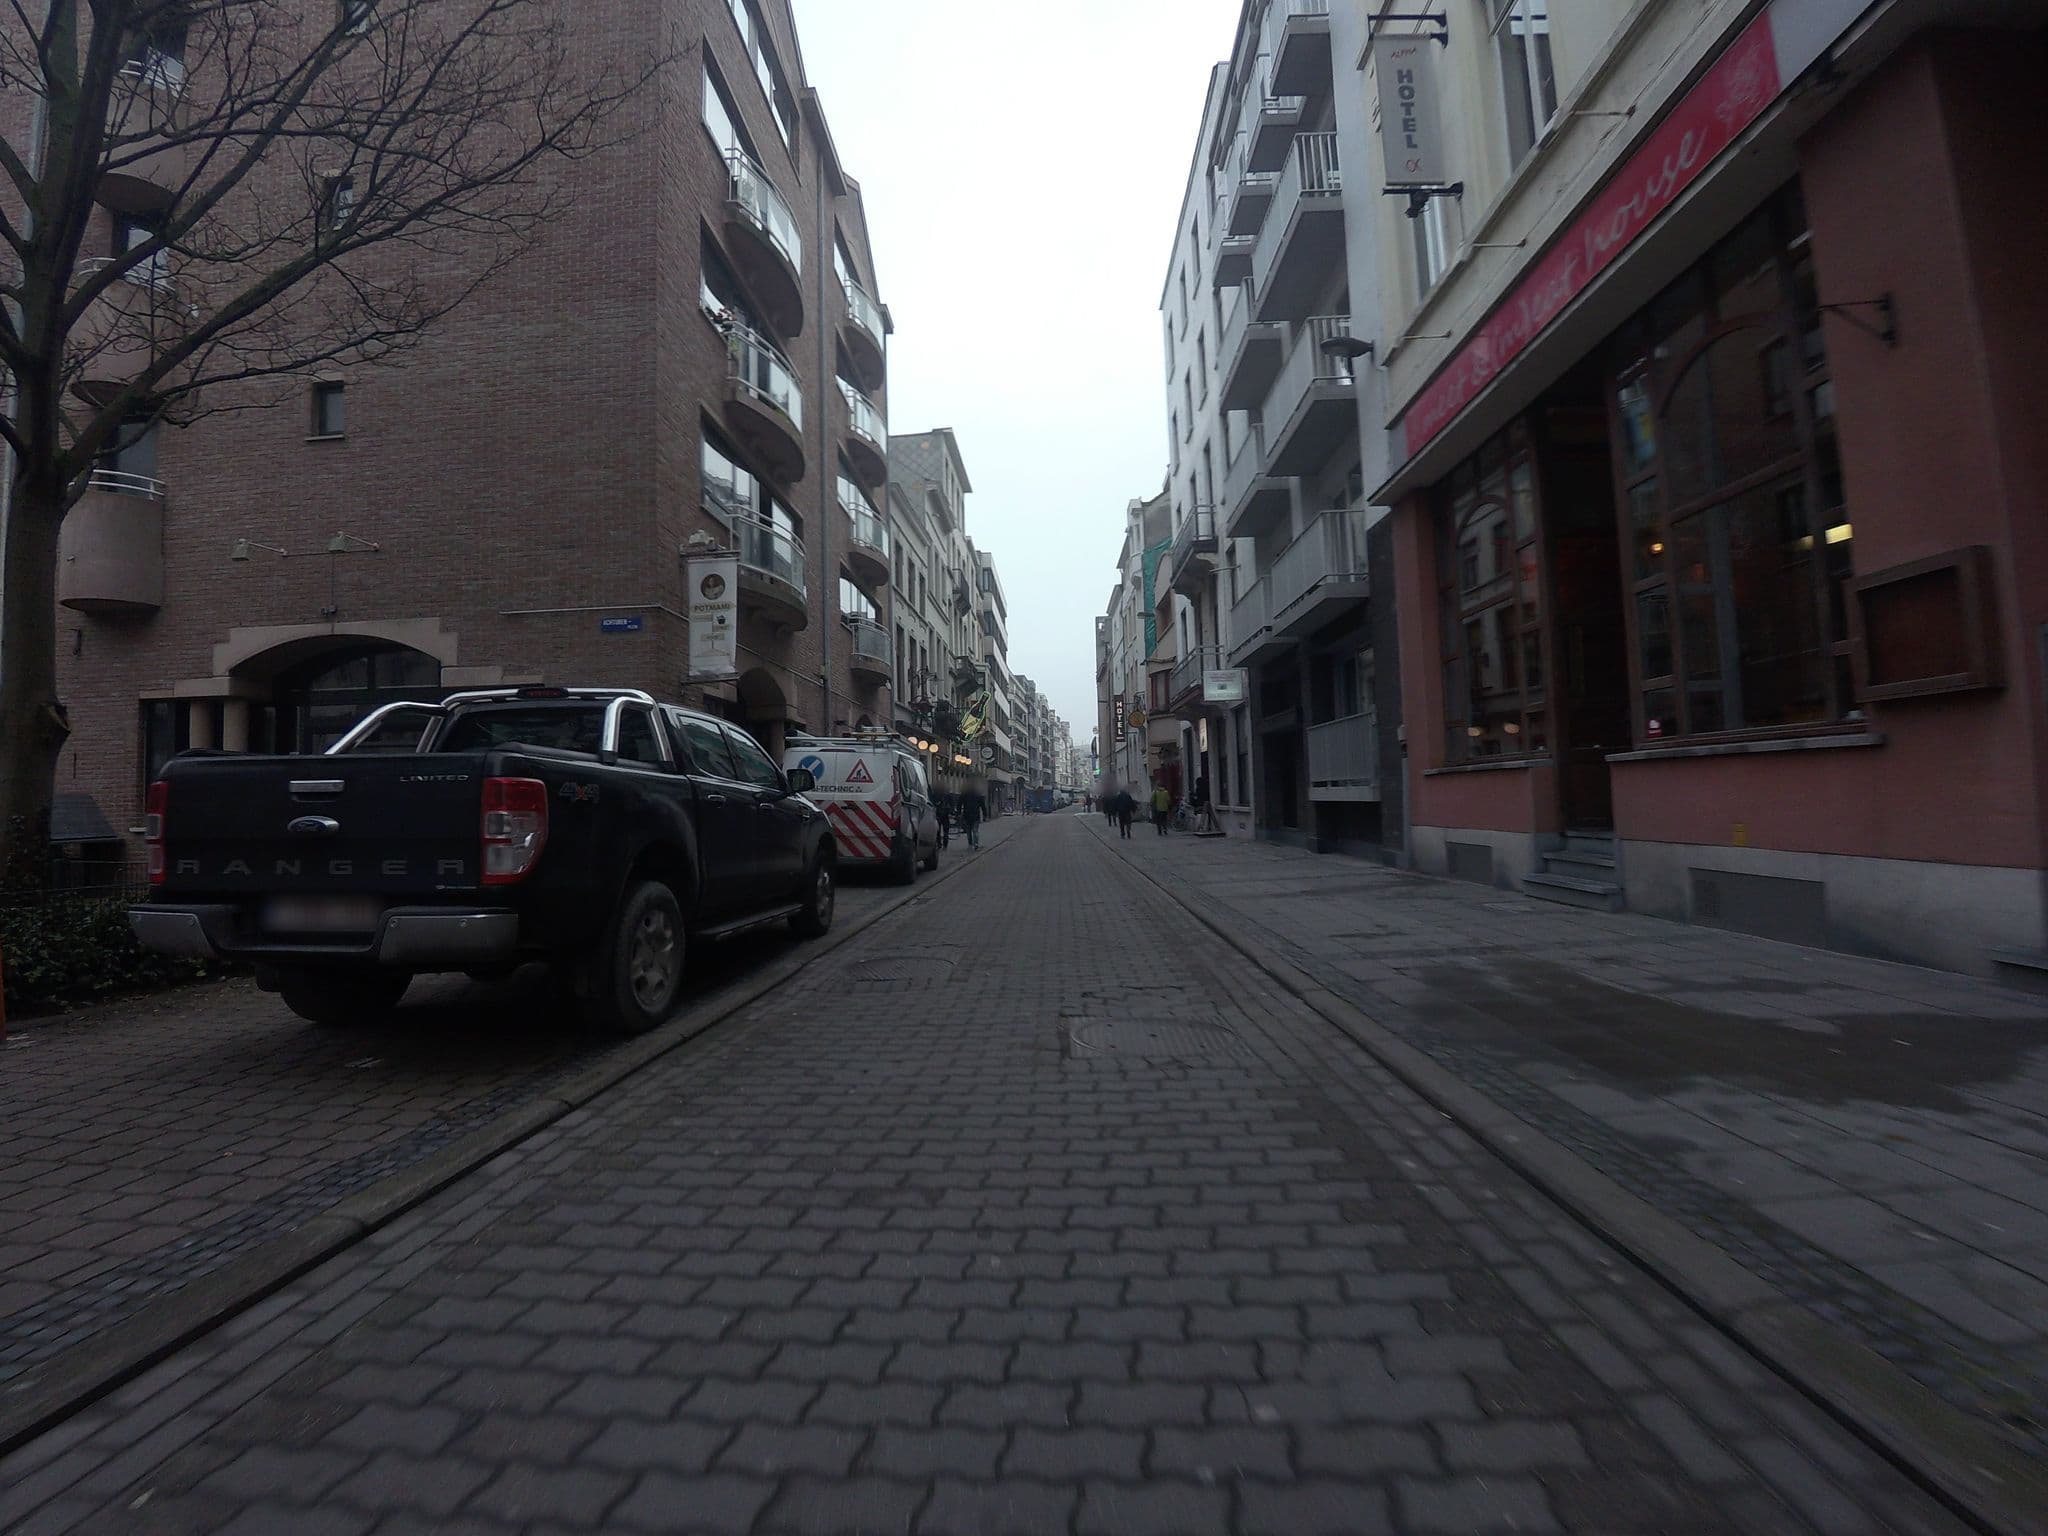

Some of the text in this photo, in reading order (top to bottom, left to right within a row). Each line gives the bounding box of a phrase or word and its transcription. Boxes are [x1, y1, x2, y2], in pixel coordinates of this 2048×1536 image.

[1396, 69, 1418, 149] HOTEL
[1583, 128, 1708, 269] house
[1115, 701, 1124, 735] HOTEL
[399, 775, 469, 783] LIMITED
[176, 859, 466, 876] RANGER
